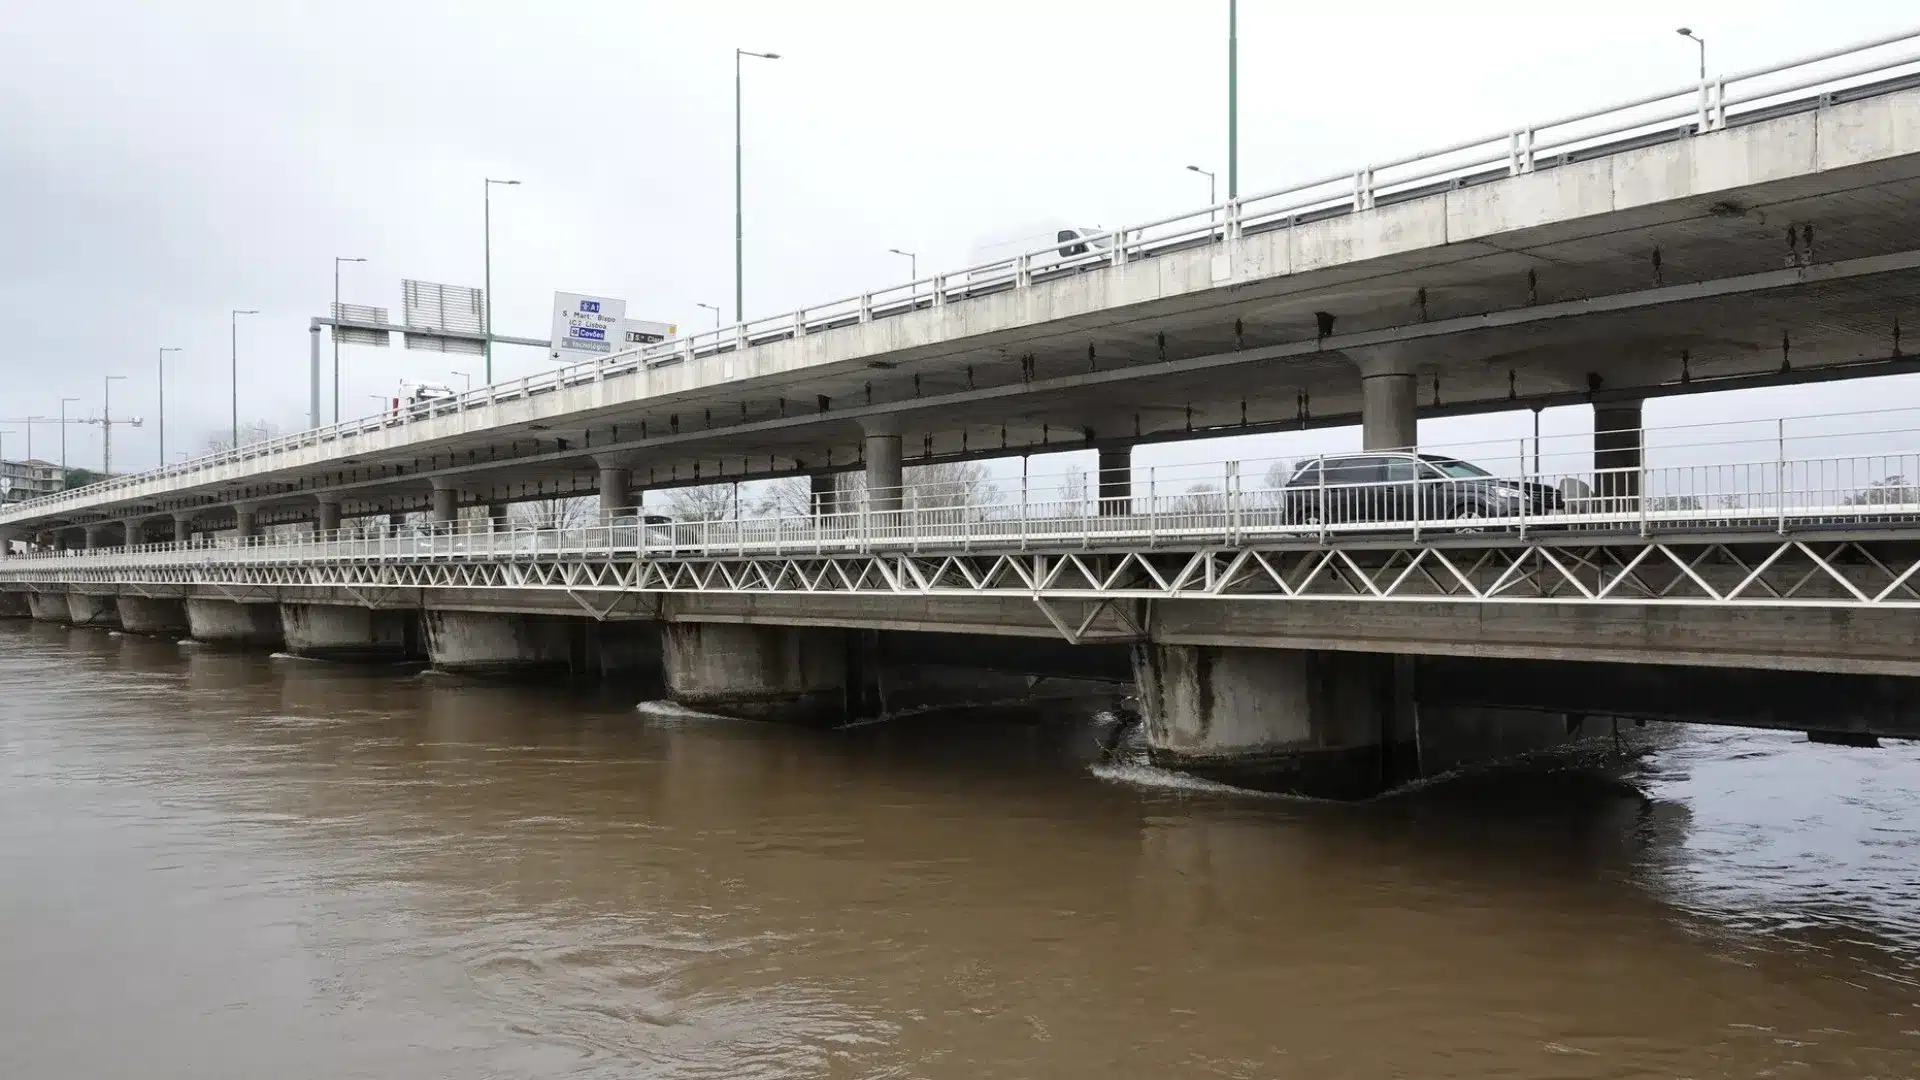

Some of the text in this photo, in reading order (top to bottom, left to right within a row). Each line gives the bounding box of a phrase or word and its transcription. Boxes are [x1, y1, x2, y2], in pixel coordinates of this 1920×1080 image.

[597, 314, 616, 323] Bispo
[585, 321, 607, 330] Lisboa
[580, 329, 604, 338] Covões
